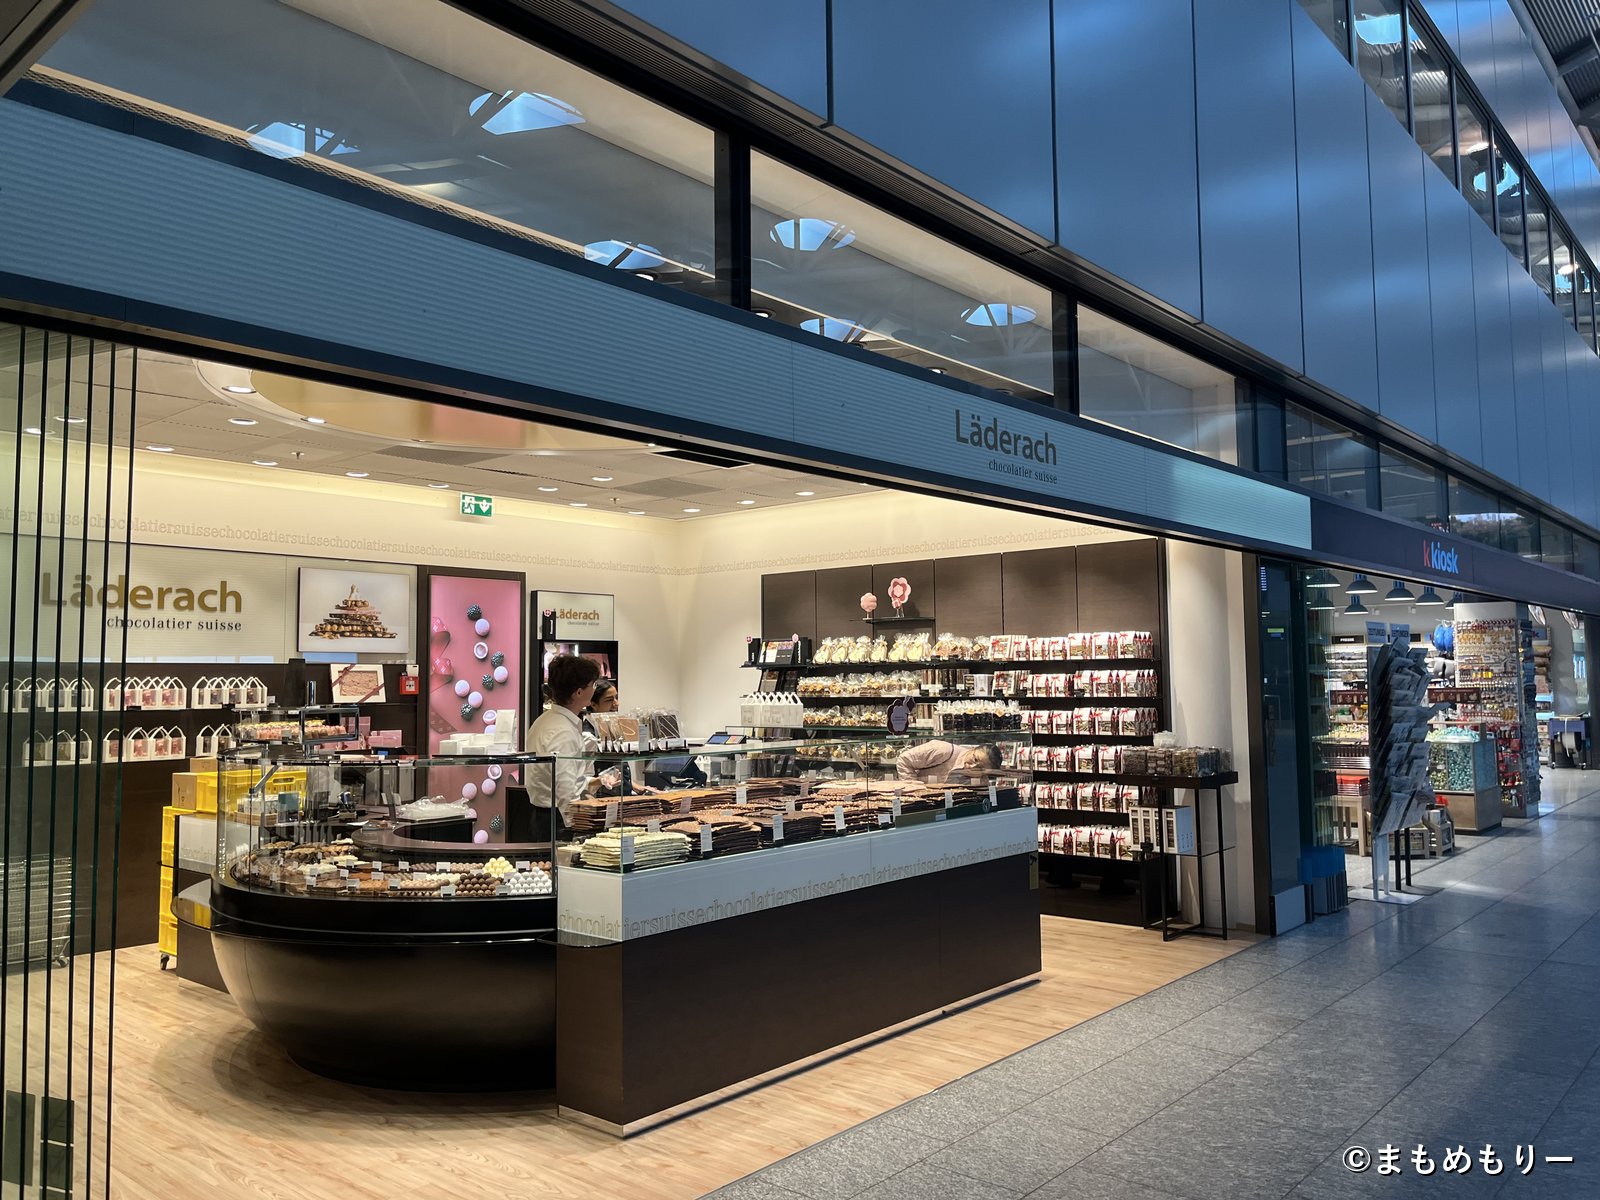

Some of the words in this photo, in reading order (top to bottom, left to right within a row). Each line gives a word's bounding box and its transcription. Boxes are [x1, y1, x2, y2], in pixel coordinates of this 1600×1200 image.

[955, 409, 1057, 466] Läderach
[988, 459, 1033, 479] chocolatier
[1034, 470, 1058, 485] suisse
[42, 571, 242, 613] Läderach
[197, 619, 242, 631] suisse
